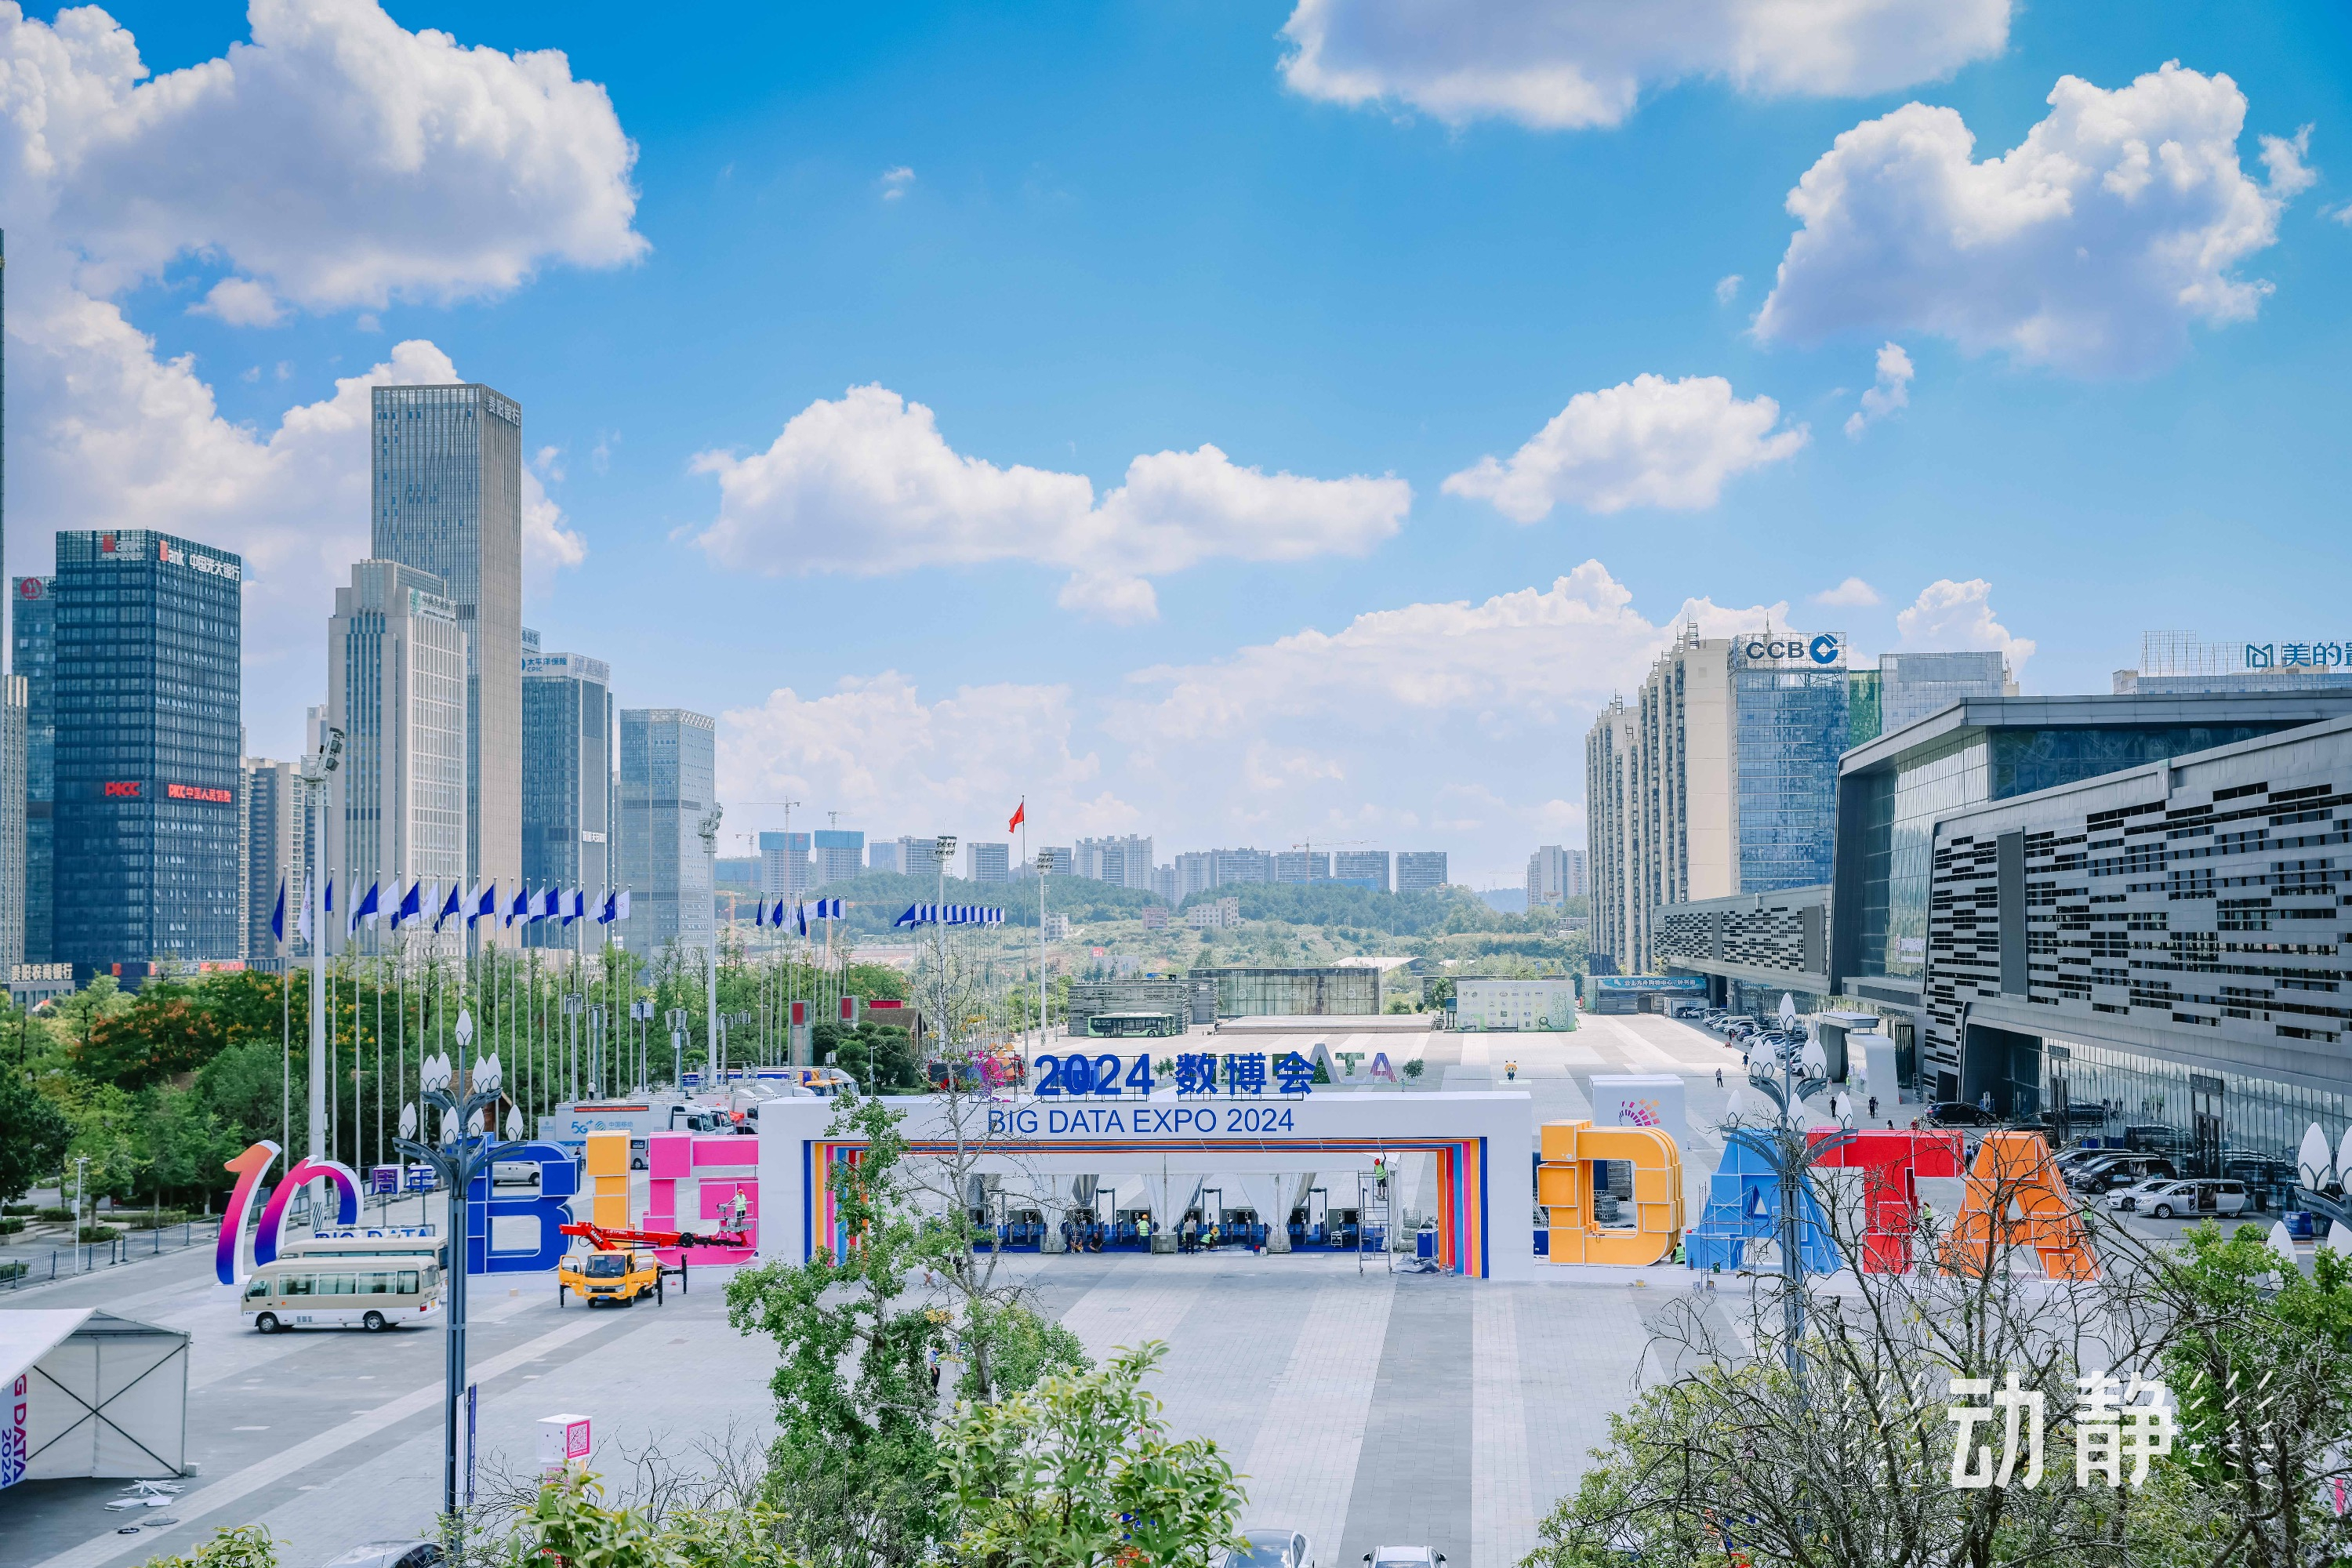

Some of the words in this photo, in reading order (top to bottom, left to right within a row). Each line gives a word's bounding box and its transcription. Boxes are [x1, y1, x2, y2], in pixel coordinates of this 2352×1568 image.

[189, 554, 240, 582] 中国光大银行
[527, 657, 568, 666] 太平洋保险
[1746, 641, 1805, 659] CCB
[105, 782, 140, 797] PICC
[1033, 1053, 1156, 1096] 2024
[1174, 1051, 1316, 1096] 数博会
[988, 1109, 1038, 1134] BIG
[1049, 1109, 1126, 1134] DATA
[1134, 1108, 1217, 1133] EXPO
[1227, 1108, 1294, 1132] 2024
[371, 1164, 440, 1196] 周年
[1537, 1119, 2104, 1281] DATA
[590, 1229, 604, 1243] SANY
[13, 1402, 27, 1483] DATA
[2, 1428, 12, 1486] 2024
